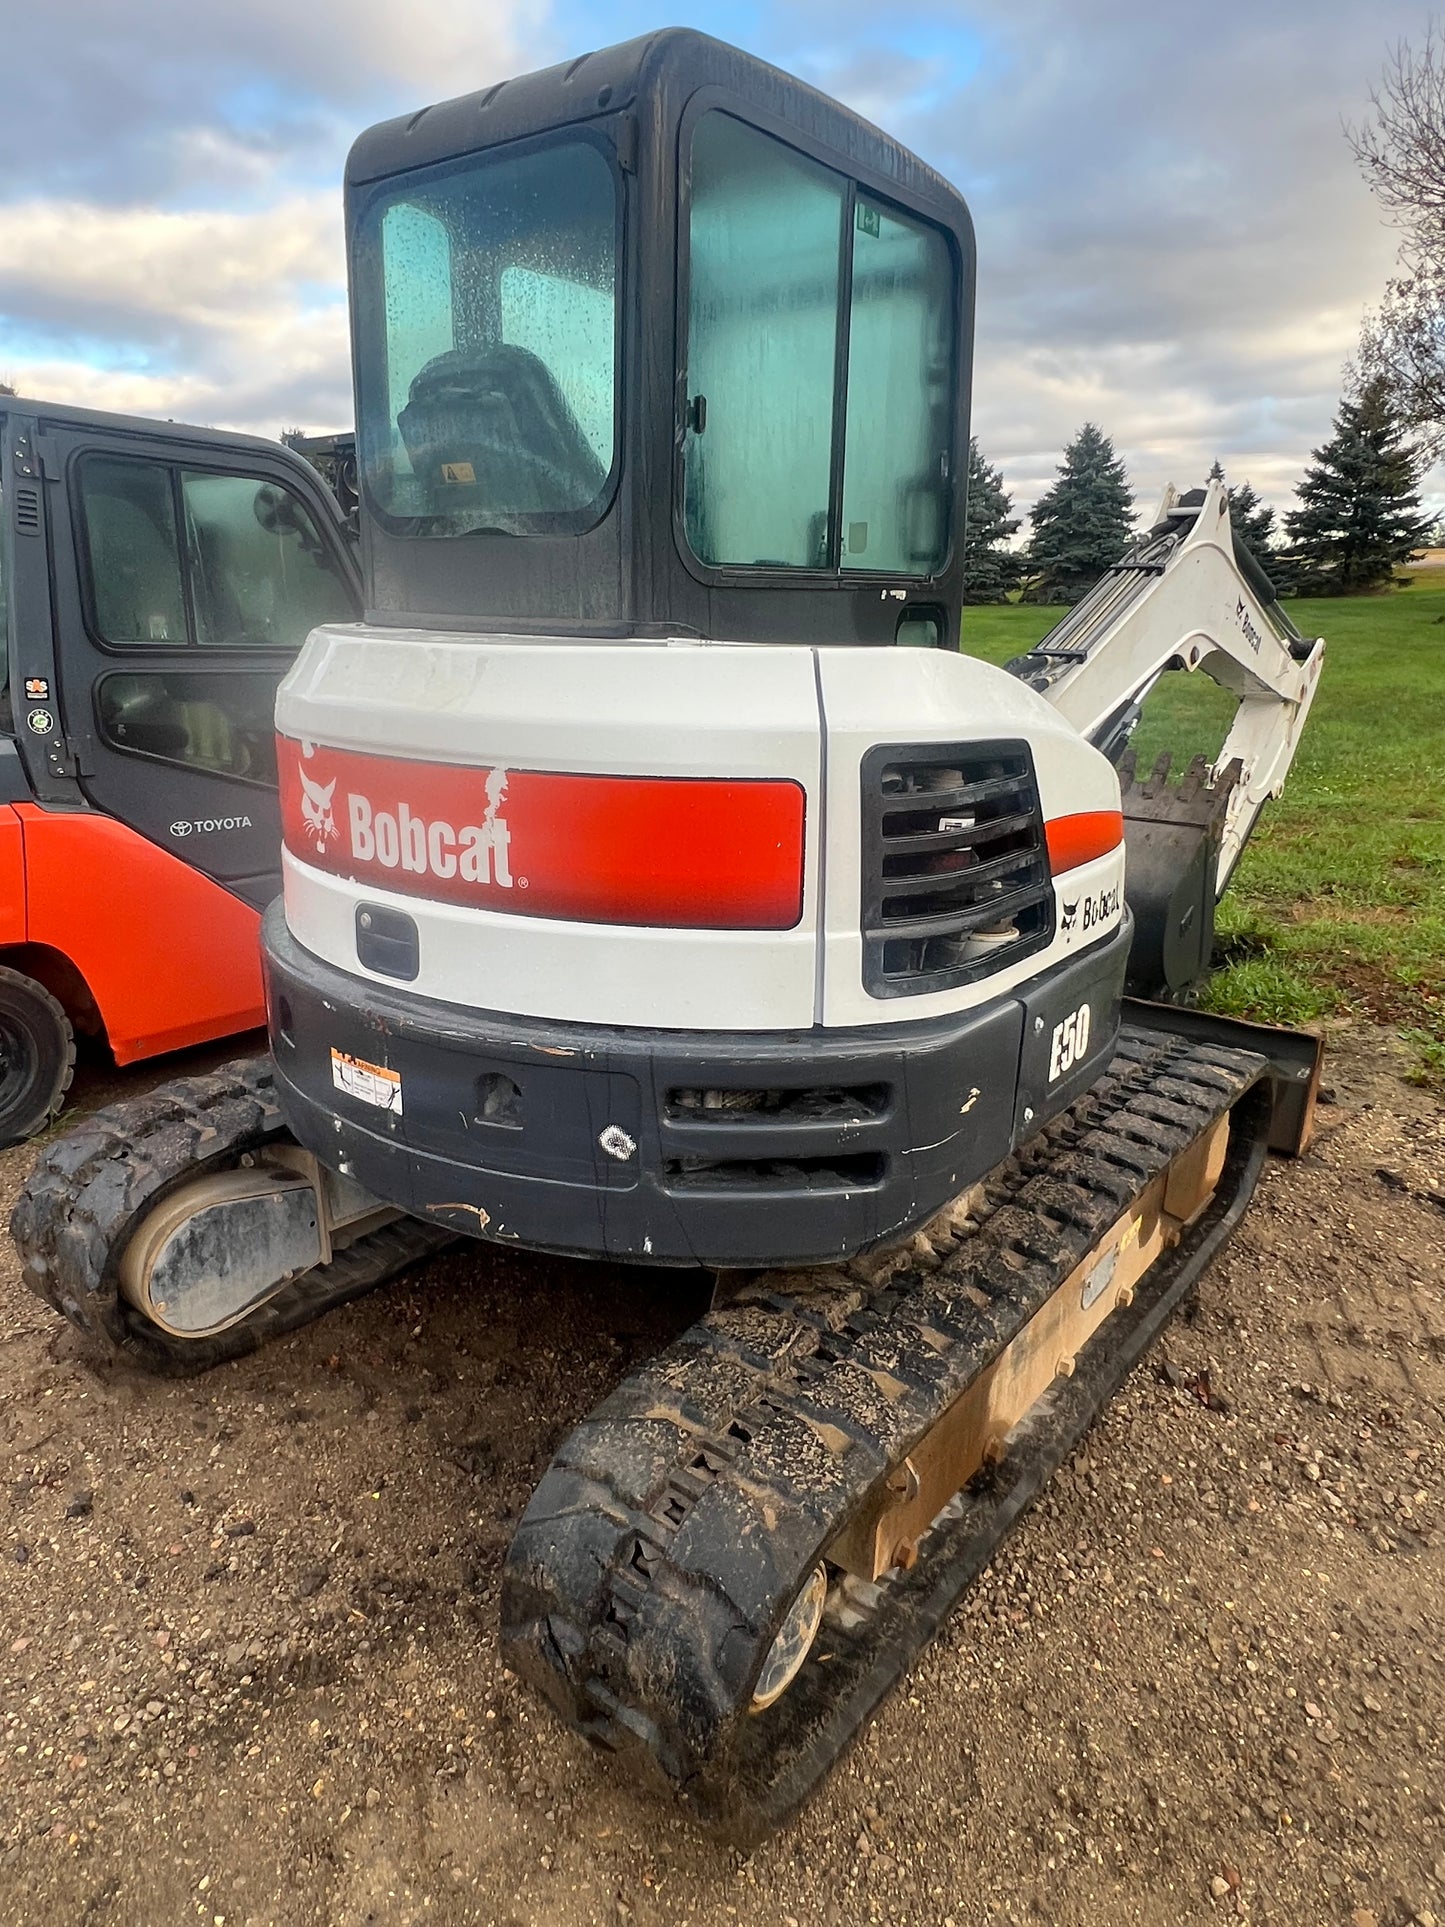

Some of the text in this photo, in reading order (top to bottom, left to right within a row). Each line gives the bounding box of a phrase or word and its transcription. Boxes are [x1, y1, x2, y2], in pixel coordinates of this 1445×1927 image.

[194, 816, 252, 833] TOYOTA
[348, 793, 513, 888] Bobcat
[1049, 1003, 1091, 1083] E50
